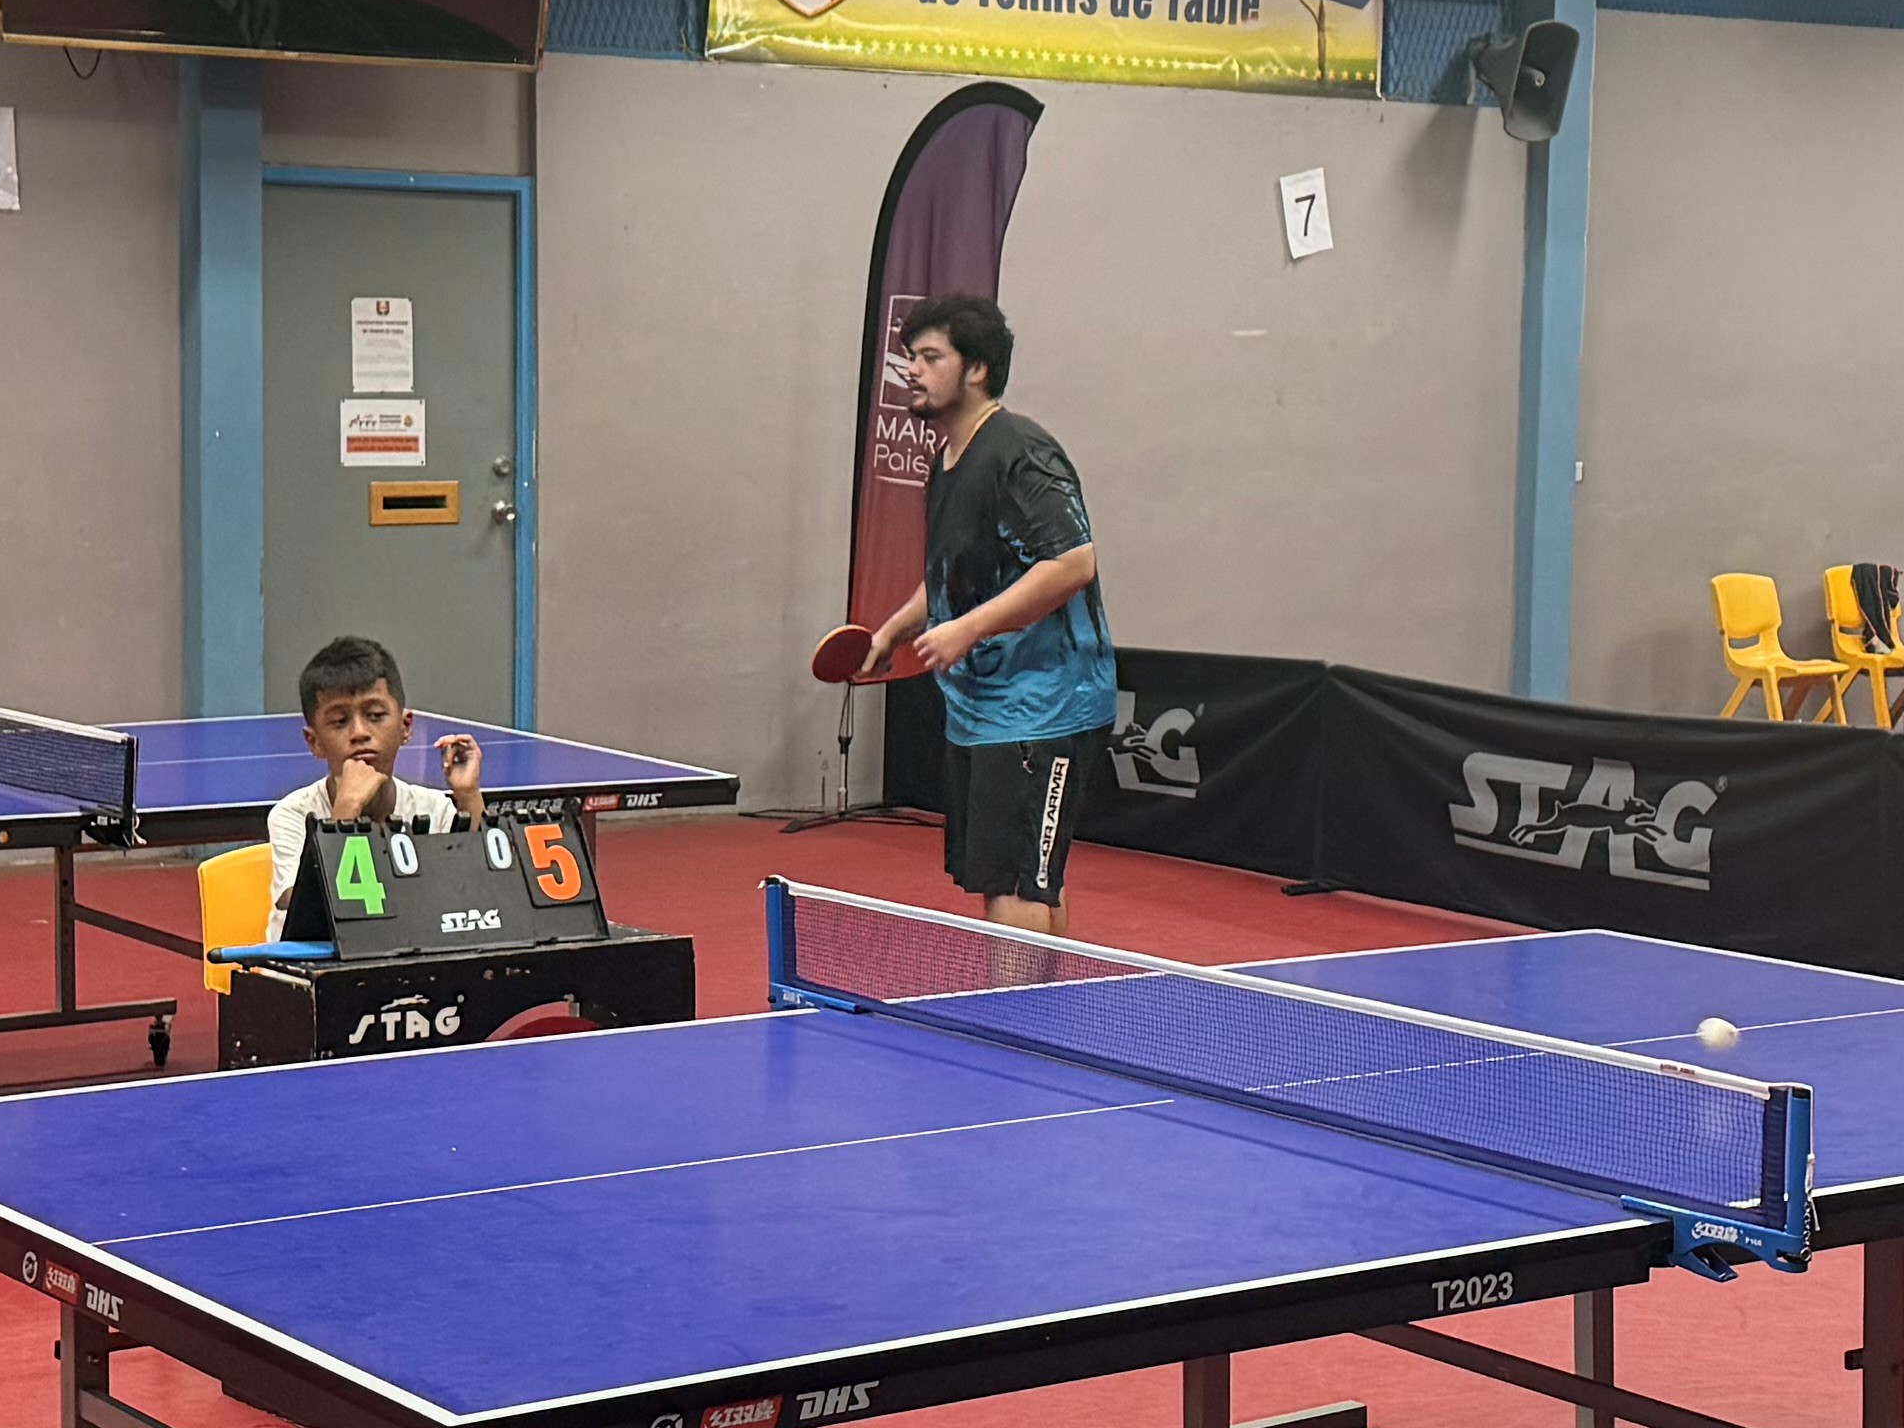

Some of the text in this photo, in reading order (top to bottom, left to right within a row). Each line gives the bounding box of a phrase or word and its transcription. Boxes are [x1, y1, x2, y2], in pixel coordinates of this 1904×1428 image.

[1294, 193, 1316, 236] 7
[626, 792, 663, 808] DHS
[1448, 751, 1718, 891] STAG
[336, 823, 582, 915] 4 0 0 5
[441, 908, 502, 933] STAG
[348, 1006, 461, 1045] STAG
[85, 1282, 124, 1322] DHS
[1432, 1271, 1514, 1312] T2023
[796, 1380, 880, 1421] DHS
